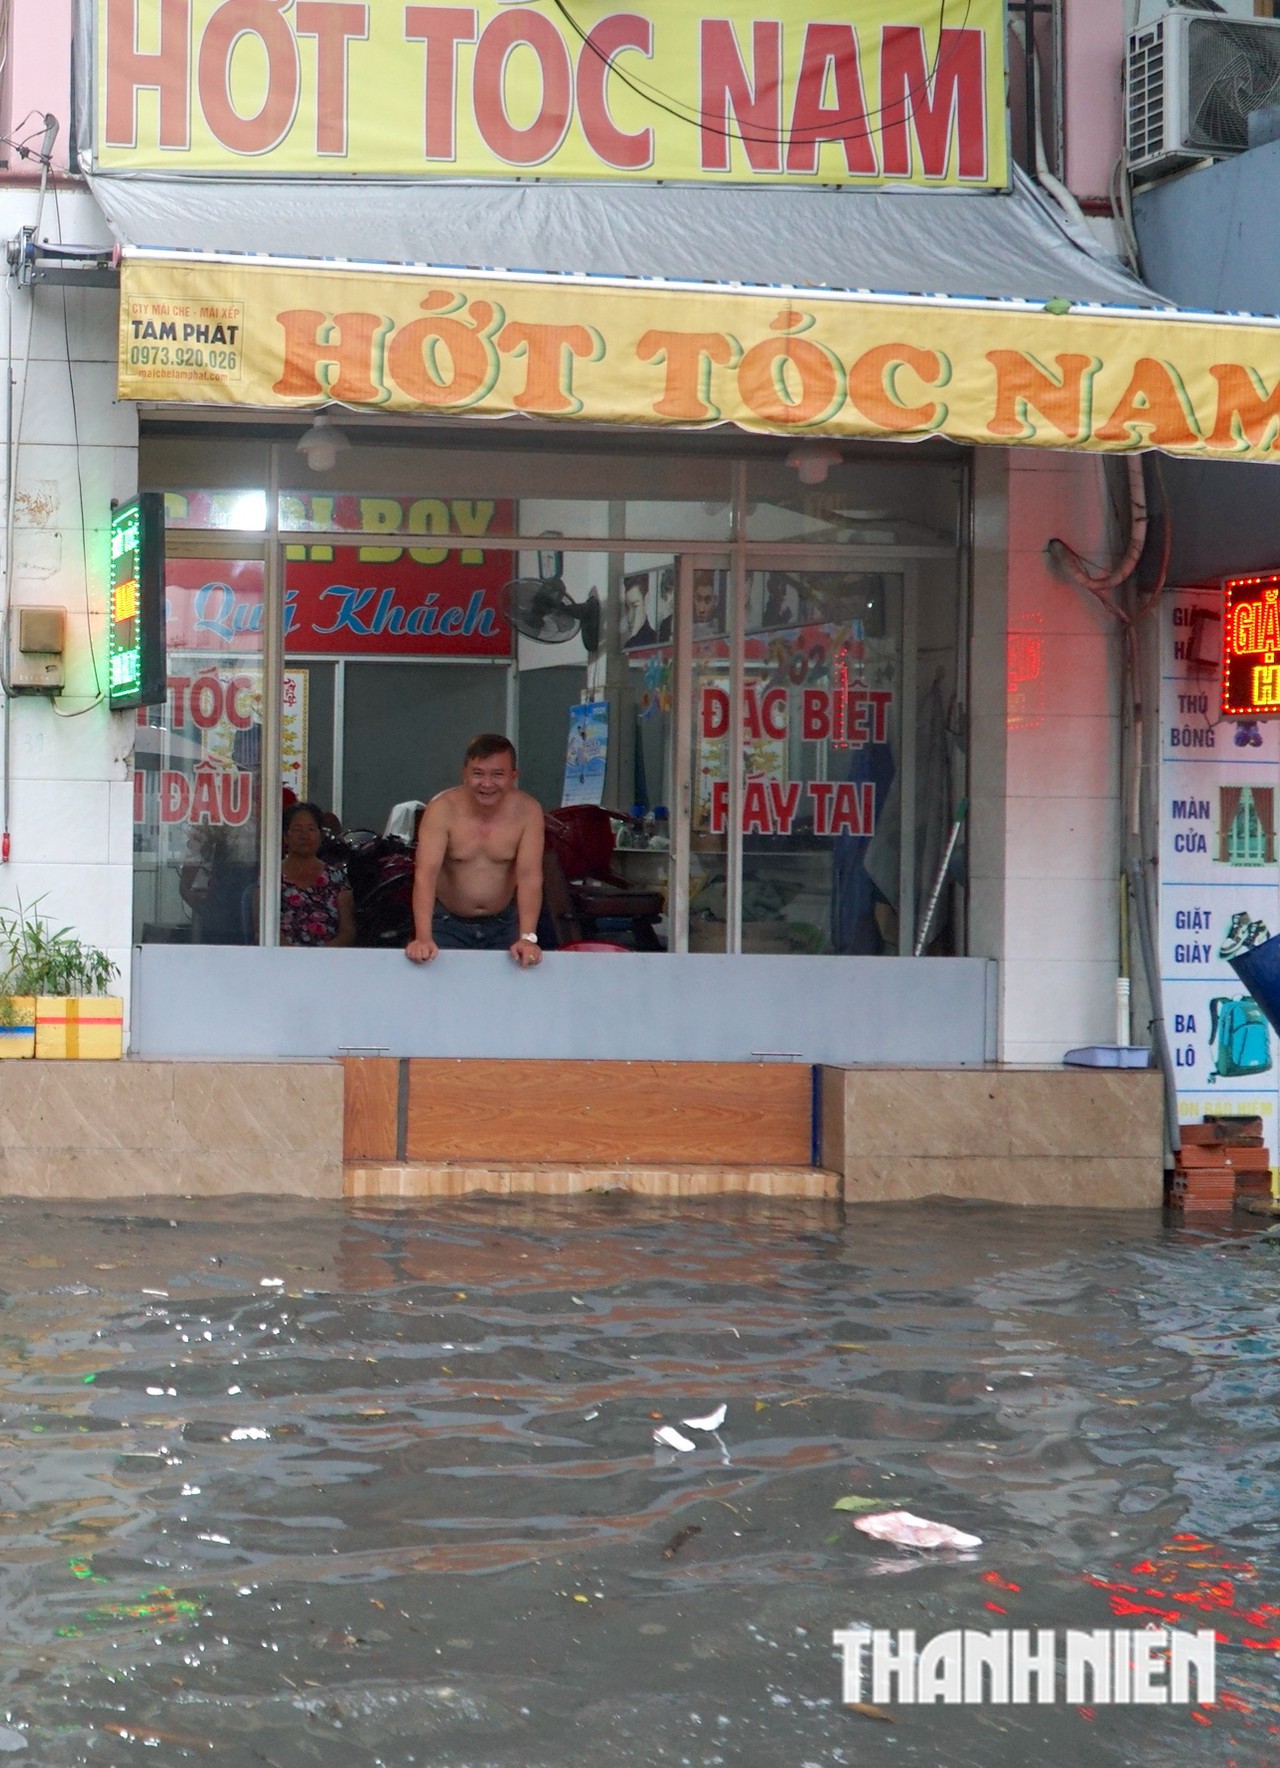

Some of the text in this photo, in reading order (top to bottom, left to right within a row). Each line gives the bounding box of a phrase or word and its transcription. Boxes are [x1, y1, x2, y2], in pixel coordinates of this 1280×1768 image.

[700, 19, 988, 181] NAM
[132, 303, 149, 314] CTY
[151, 303, 170, 315] MÁI
[173, 305, 190, 316] CHE
[200, 305, 218, 318] MÁI
[183, 322, 239, 345] PHÁT
[272, 289, 1280, 452] HỚT TÓC NAM
[359, 498, 494, 565] BOY
[312, 585, 499, 636] Khách
[1233, 589, 1280, 663] GIẶ
[167, 666, 253, 730] TÓC
[1177, 691, 1208, 714] THÚ
[802, 679, 893, 749] BIỆT
[1171, 724, 1215, 748] BÔNG
[160, 755, 252, 826] ĐẦU
[808, 781, 875, 836] TAI
[1172, 796, 1210, 820] MÀN
[1174, 827, 1207, 853] CỬA
[1175, 907, 1212, 935] GIẶT
[1174, 940, 1212, 963] GIÀY
[1175, 1014, 1196, 1033] BA
[1176, 1045, 1195, 1067] LÔ
